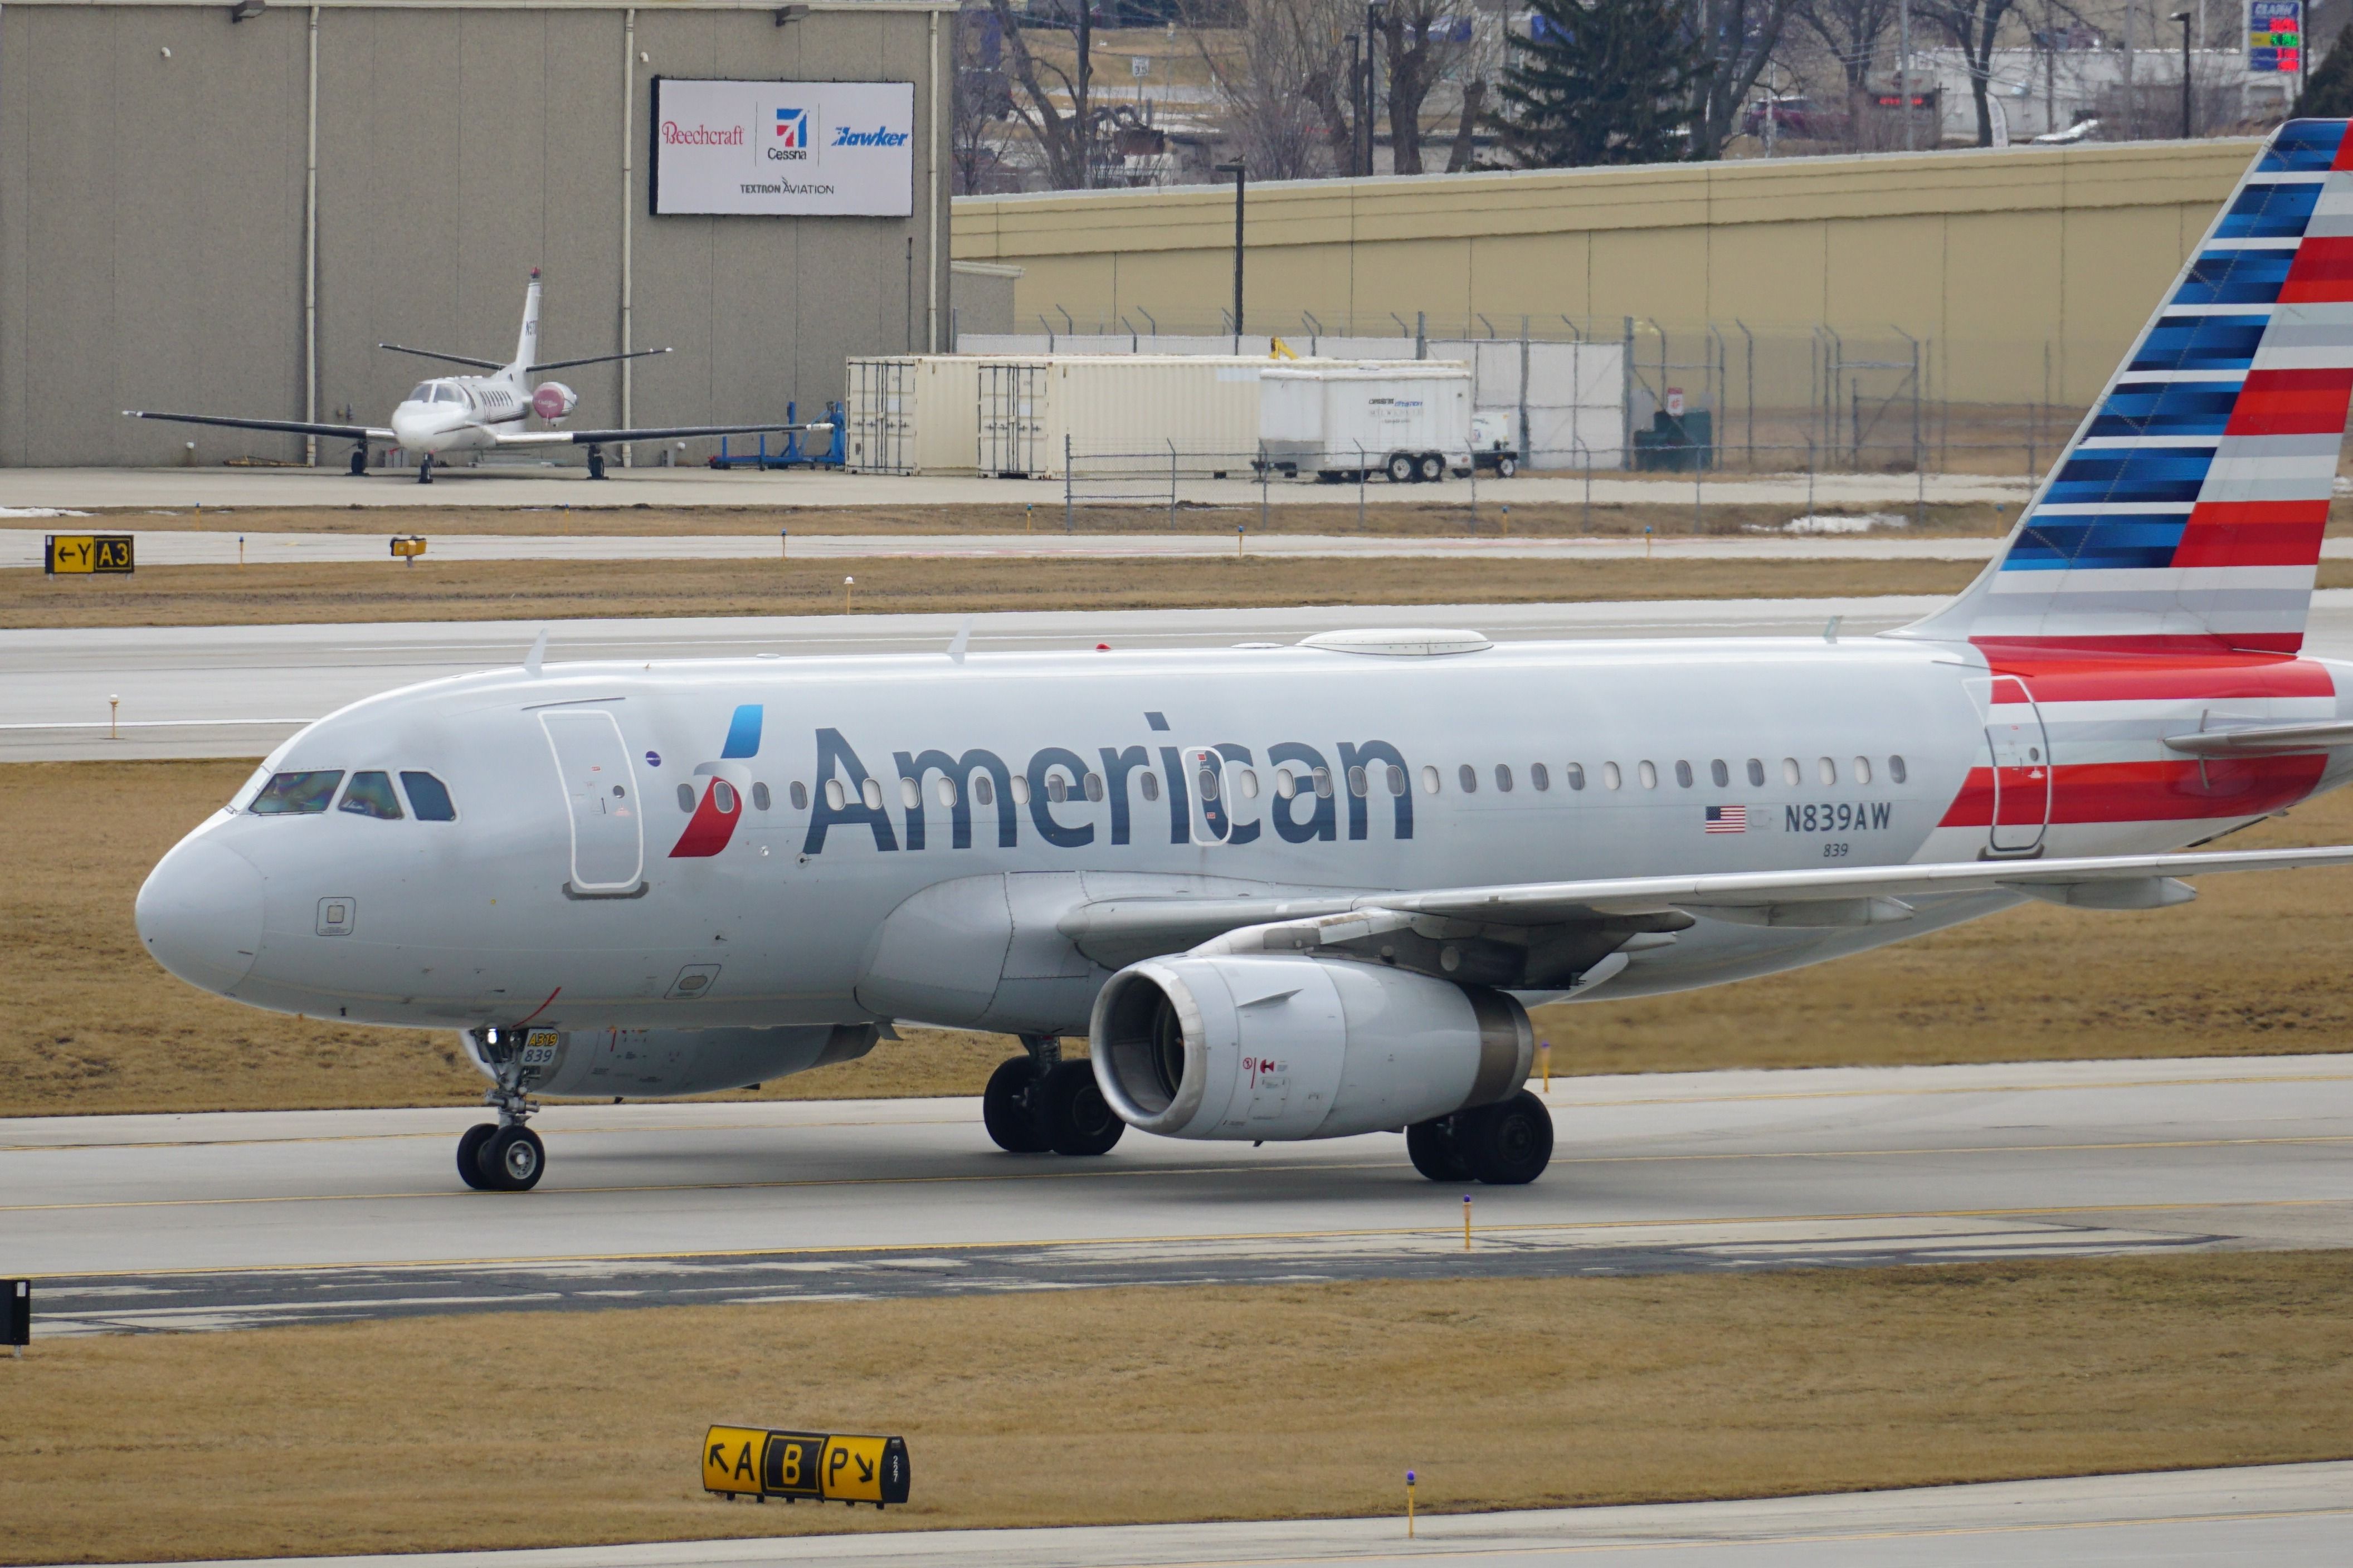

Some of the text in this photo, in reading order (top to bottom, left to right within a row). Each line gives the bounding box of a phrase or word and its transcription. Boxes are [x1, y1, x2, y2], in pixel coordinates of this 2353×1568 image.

[662, 121, 744, 146] Beechcraft
[831, 126, 908, 146] Hawker
[767, 148, 807, 160] Cessna
[741, 183, 835, 195] TEXTRON AVIATION
[77, 543, 129, 566] Y A3
[802, 711, 1414, 854] American
[1785, 802, 1891, 832] N839AW
[1823, 843, 1848, 857] 839
[528, 1033, 558, 1047] A319
[525, 1049, 552, 1062] 839
[734, 1441, 849, 1487] A B P
